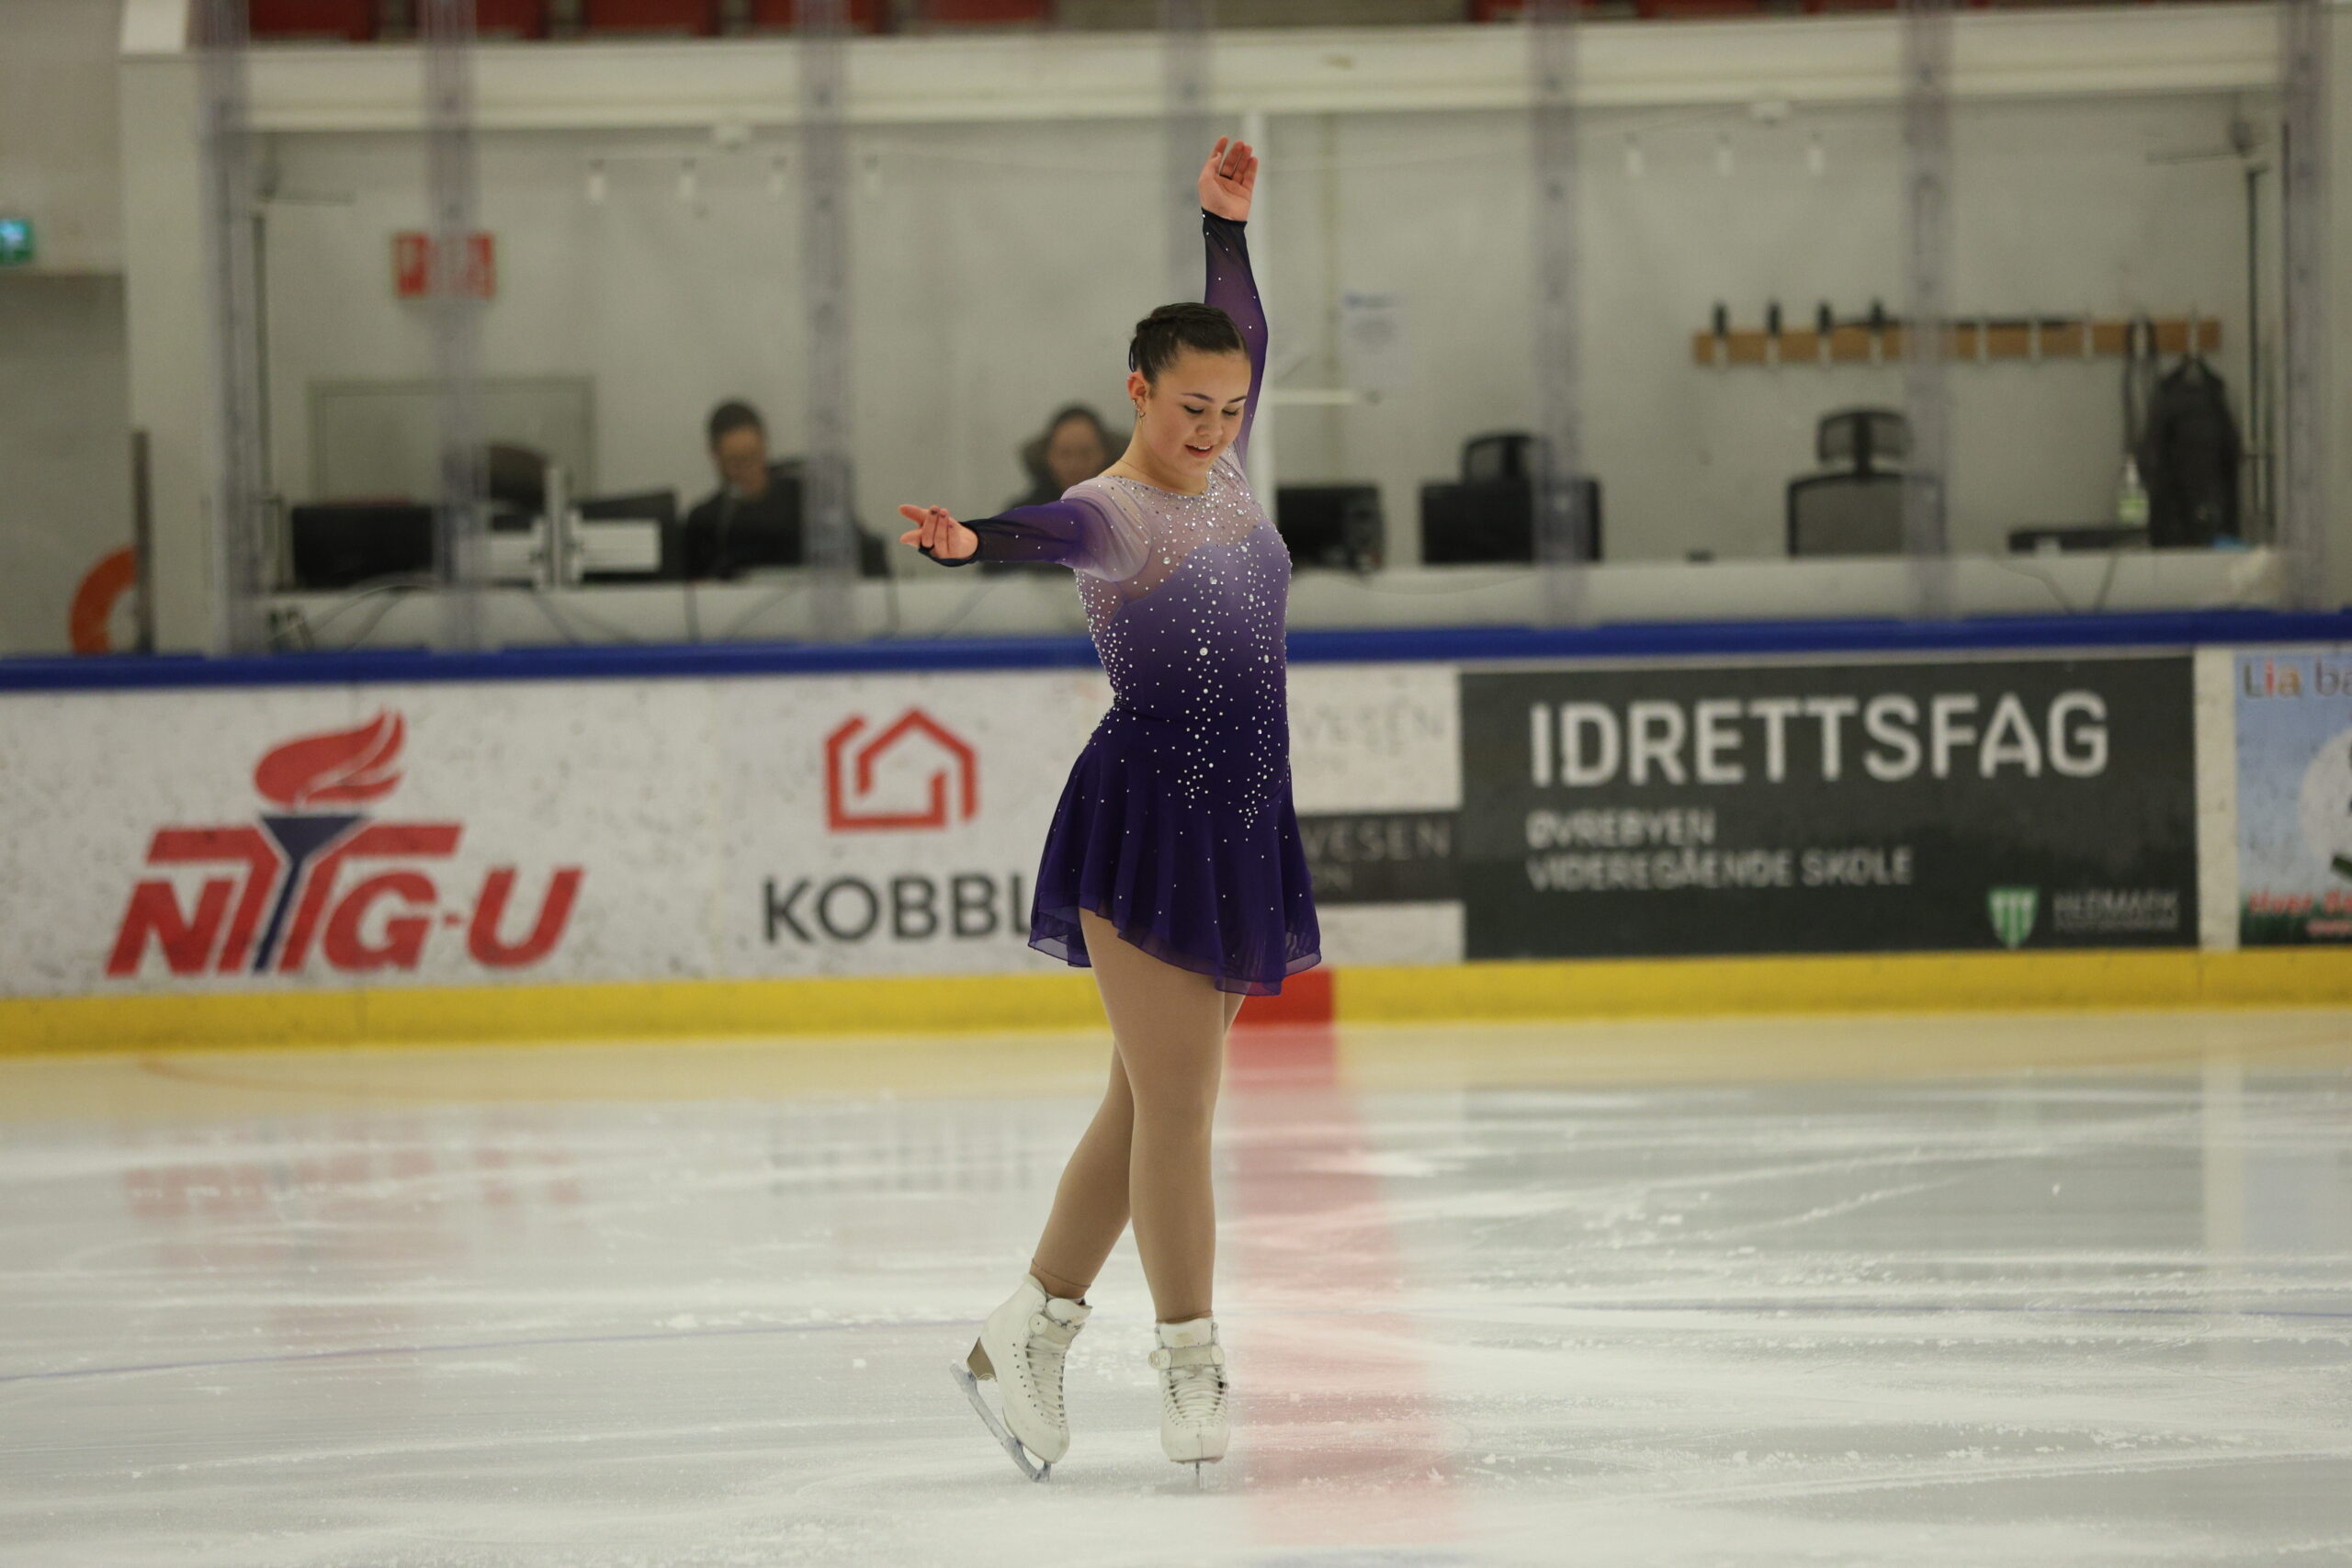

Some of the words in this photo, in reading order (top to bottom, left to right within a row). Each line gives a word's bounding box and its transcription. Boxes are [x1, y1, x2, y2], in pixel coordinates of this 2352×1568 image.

[2243, 657, 2301, 698] Lia
[1529, 690, 2109, 788] IDRETTSFAG
[1800, 845, 1915, 887] SKOLE
[762, 873, 1034, 945] KOBBL
